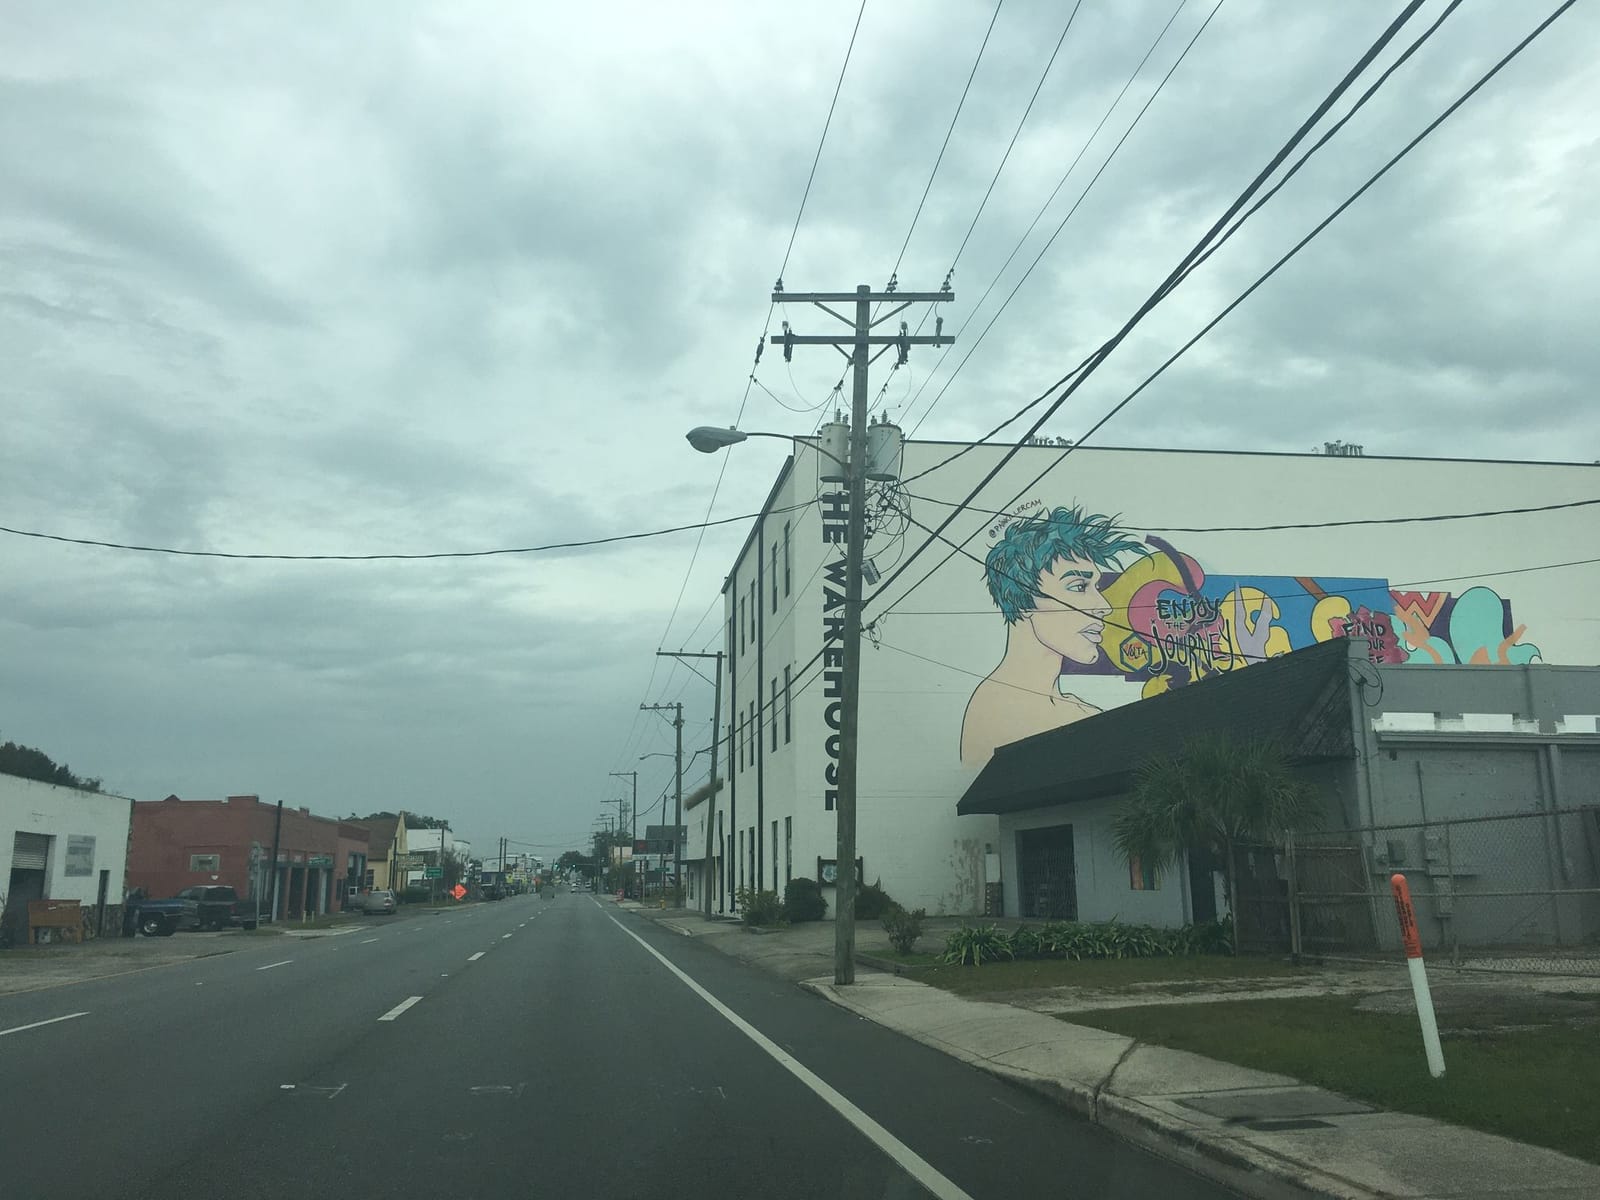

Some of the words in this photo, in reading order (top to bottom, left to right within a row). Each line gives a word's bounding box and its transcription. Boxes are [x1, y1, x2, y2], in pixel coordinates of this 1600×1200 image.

[822, 479, 850, 543] HE
[1156, 597, 1220, 624] ENJOY
[1165, 622, 1185, 630] THE
[1148, 619, 1233, 680] JOURNEY
[1368, 638, 1386, 651] OUR
